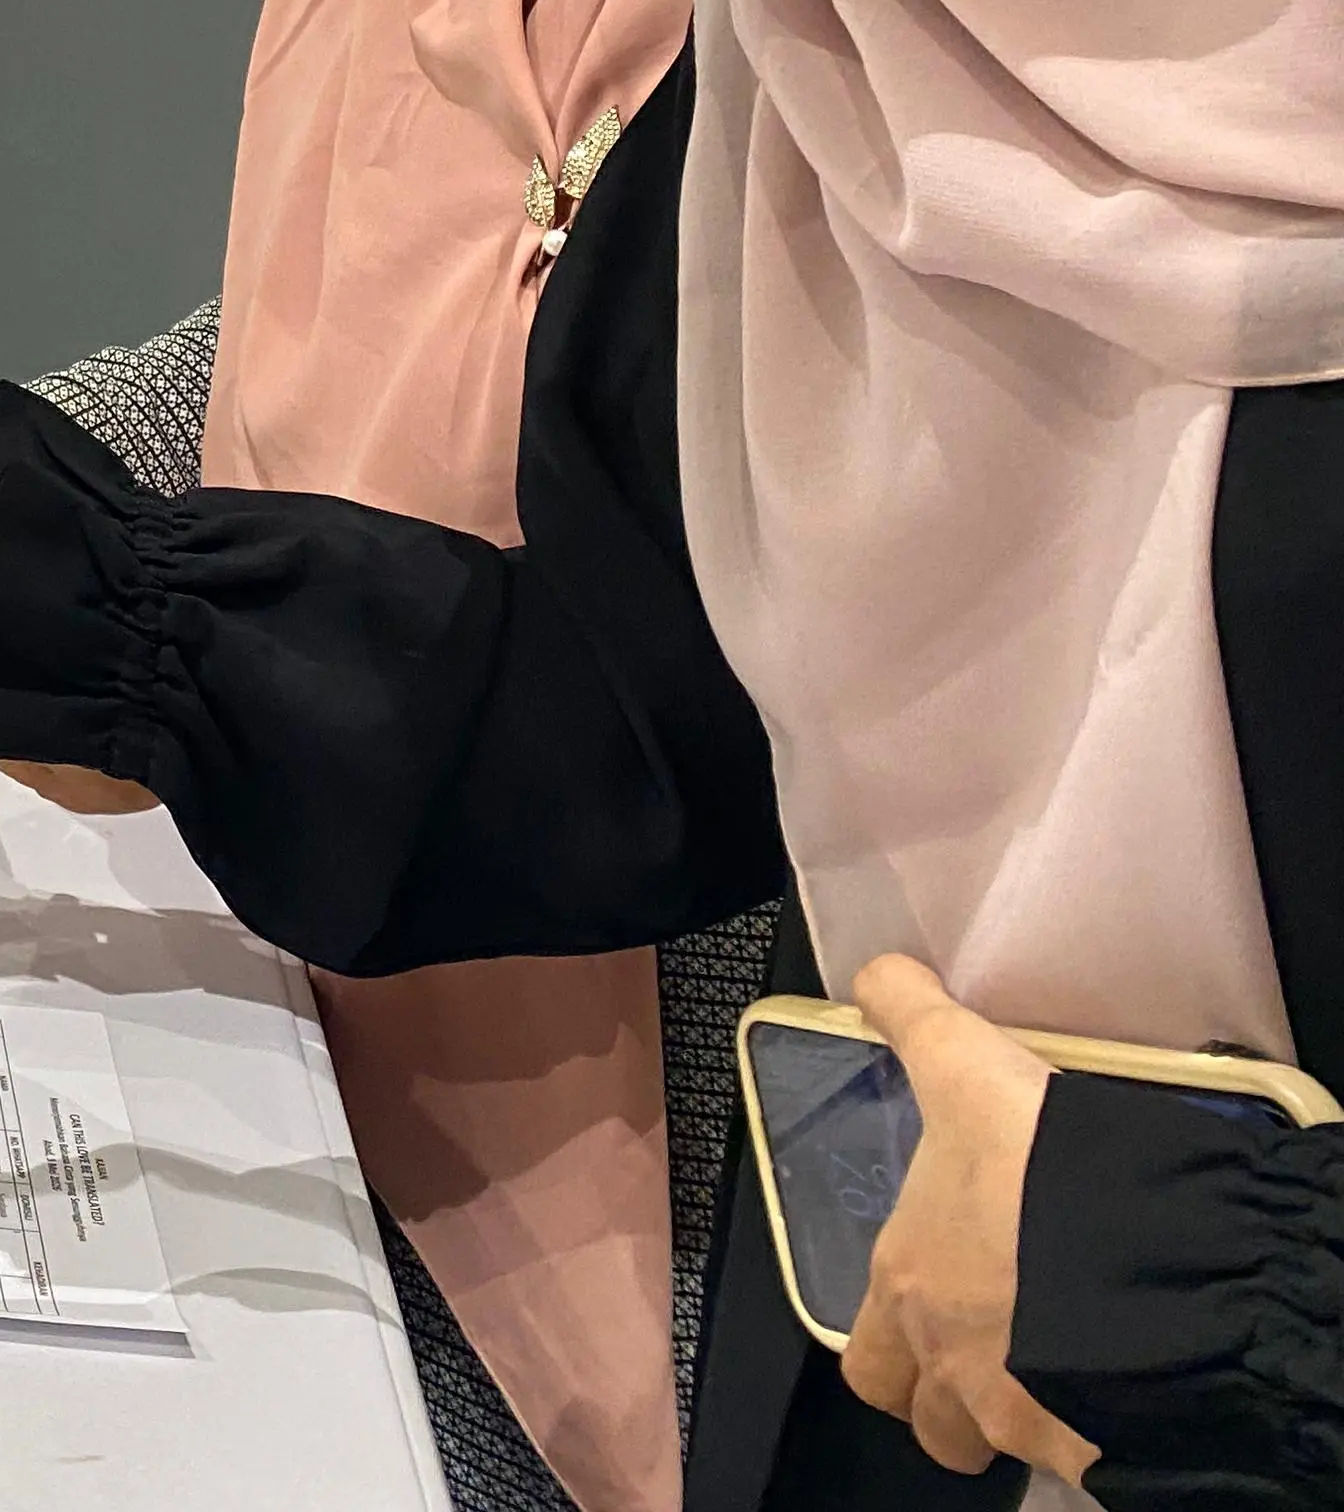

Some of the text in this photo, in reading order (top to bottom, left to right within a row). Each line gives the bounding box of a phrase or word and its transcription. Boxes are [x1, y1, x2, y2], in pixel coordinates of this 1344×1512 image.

[67, 1113, 105, 1226] CAN THIS LOVE BE TRANSLATED?
